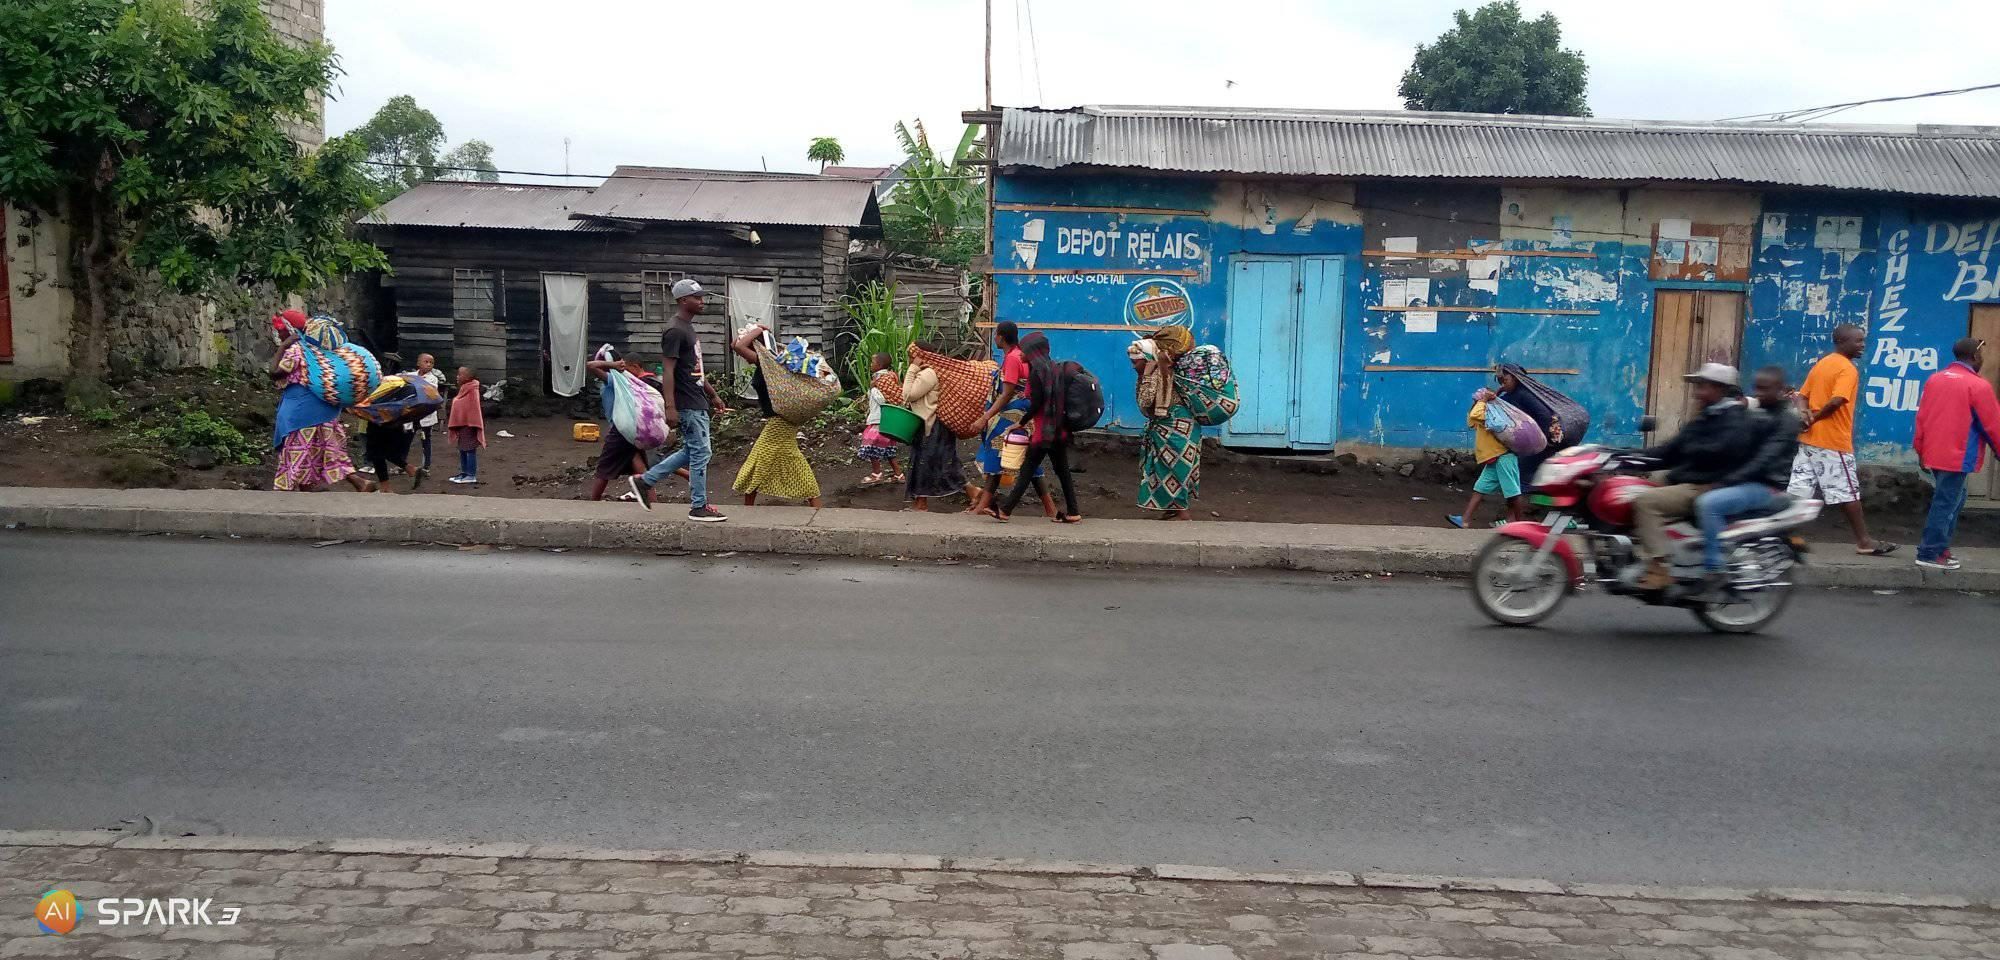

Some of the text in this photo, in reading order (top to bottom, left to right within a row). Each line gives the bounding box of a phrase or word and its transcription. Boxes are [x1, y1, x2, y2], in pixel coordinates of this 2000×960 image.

[1057, 227, 1202, 260] DEPOT RELAIS
[1050, 273, 1084, 285] GROS
[1096, 273, 1128, 285] DETAIL
[1879, 229, 1910, 332] CHEZ
[1870, 337, 1938, 378] Papa
